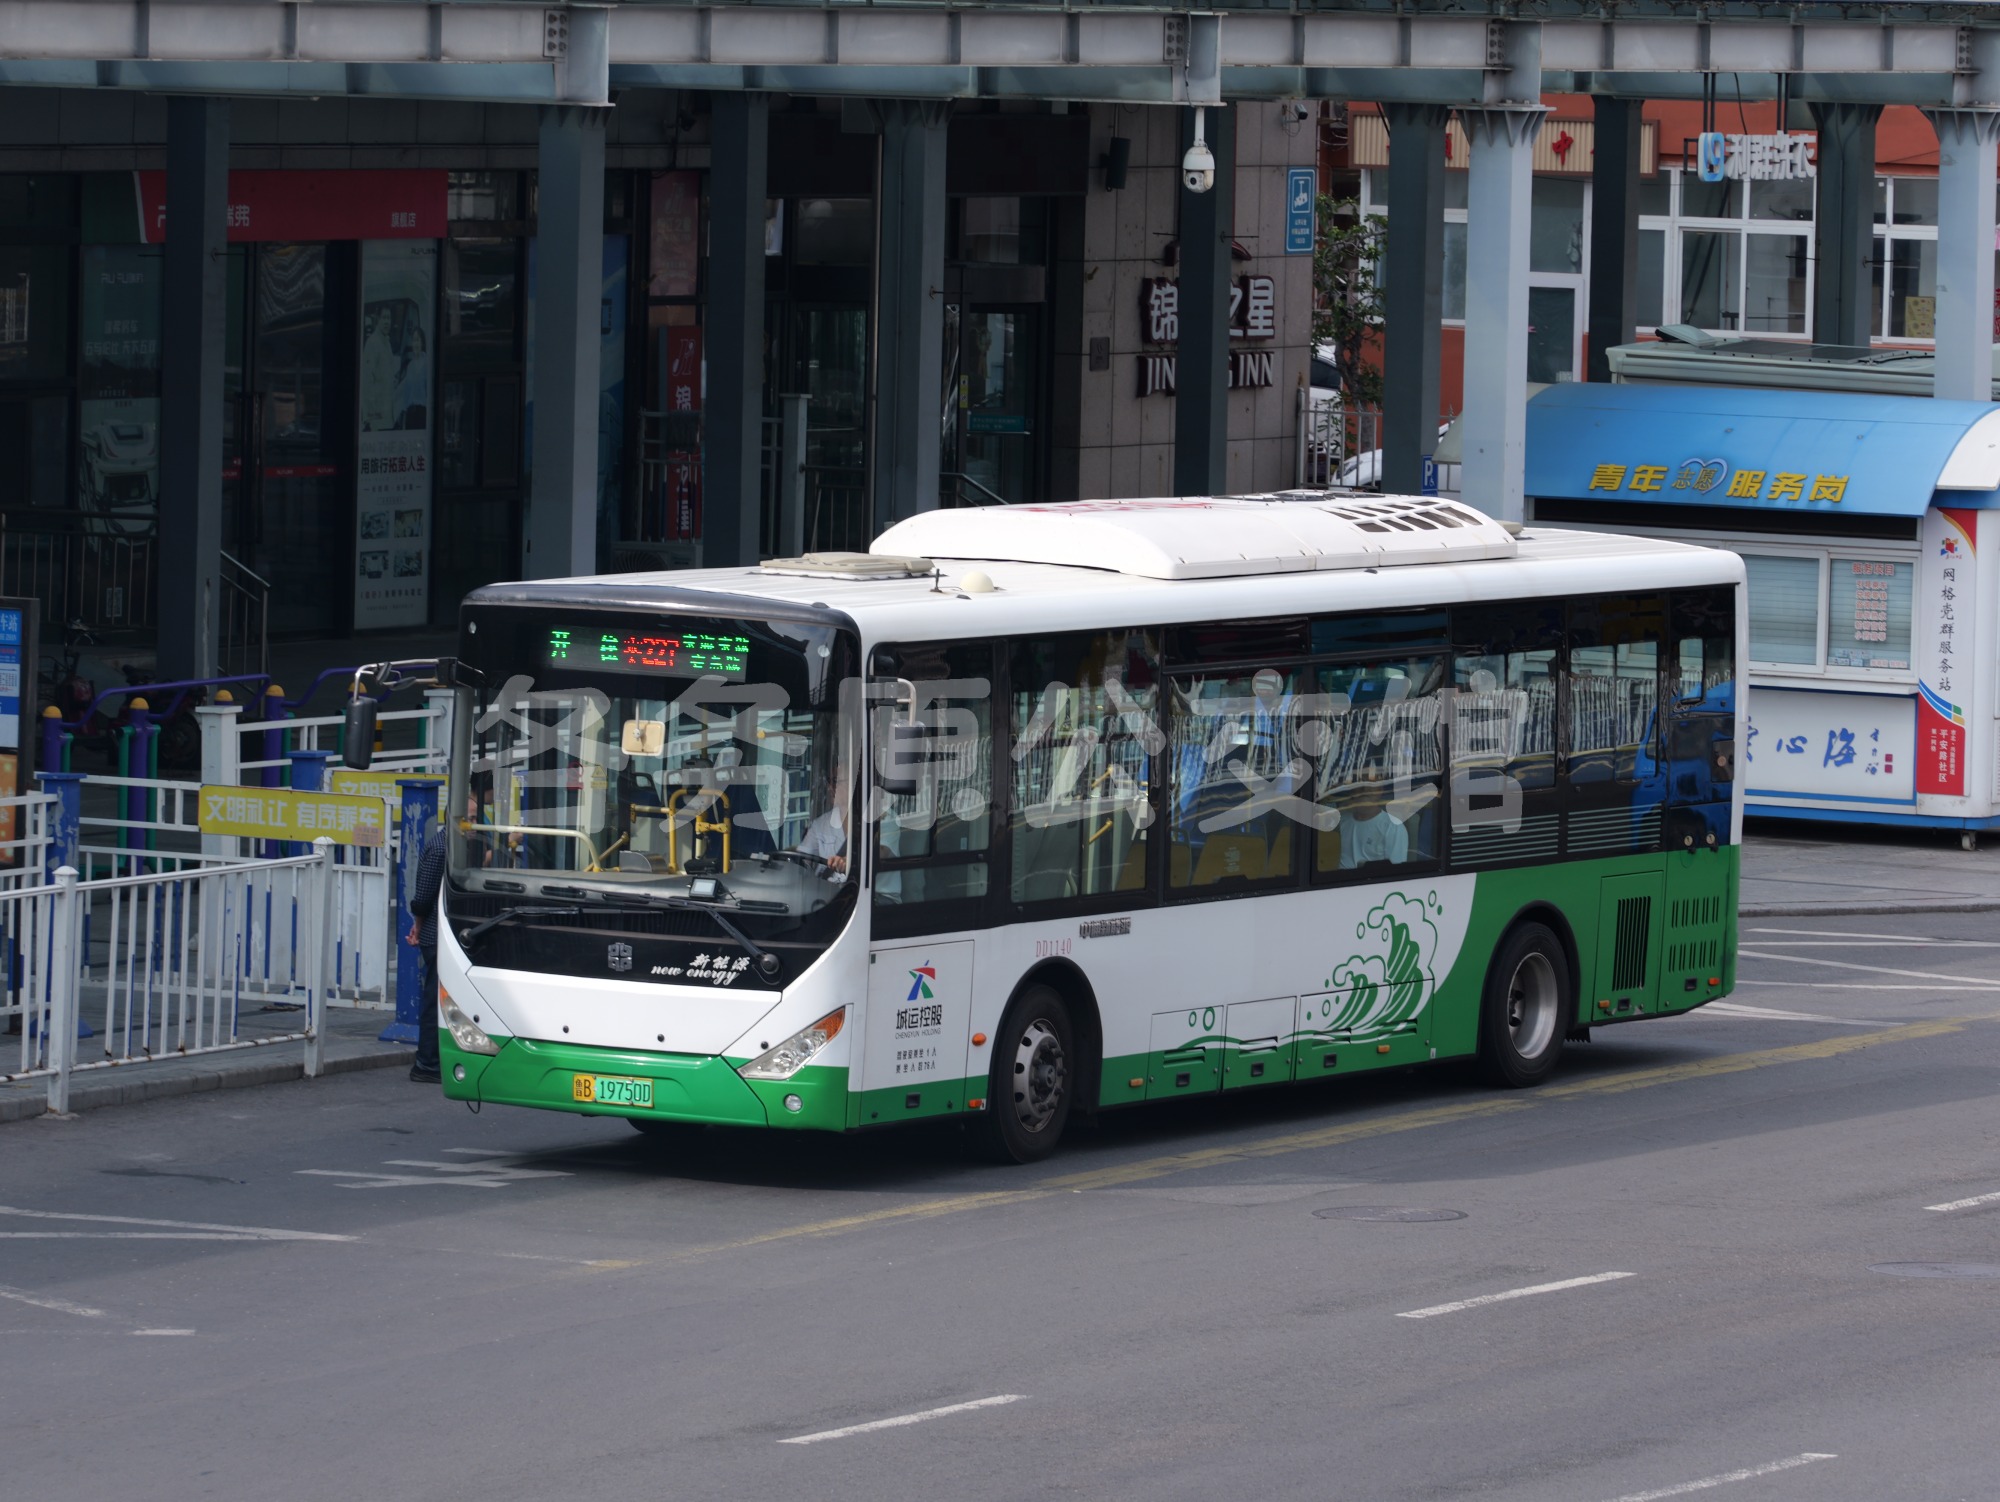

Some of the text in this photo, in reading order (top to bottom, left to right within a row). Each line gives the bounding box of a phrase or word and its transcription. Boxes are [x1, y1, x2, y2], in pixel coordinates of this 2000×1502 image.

[1725, 130, 1817, 180] 利群洗衣
[391, 212, 417, 229] 旗舰店
[1150, 278, 1275, 341] 锦之星
[361, 456, 426, 475] 用旅行拓宽人生
[1853, 562, 1895, 576] 服务项目
[1938, 567, 1957, 692] 网格党群服务站
[1939, 729, 1948, 782] 平安路社区
[205, 795, 379, 831] 文明礼让 有序乘车
[1036, 938, 1071, 957] DD1140
[689, 953, 750, 971] 新能源
[650, 965, 740, 985] new energy
[896, 1004, 942, 1030] 城运控股
[895, 1027, 942, 1040] CHENGYUN HOLDING
